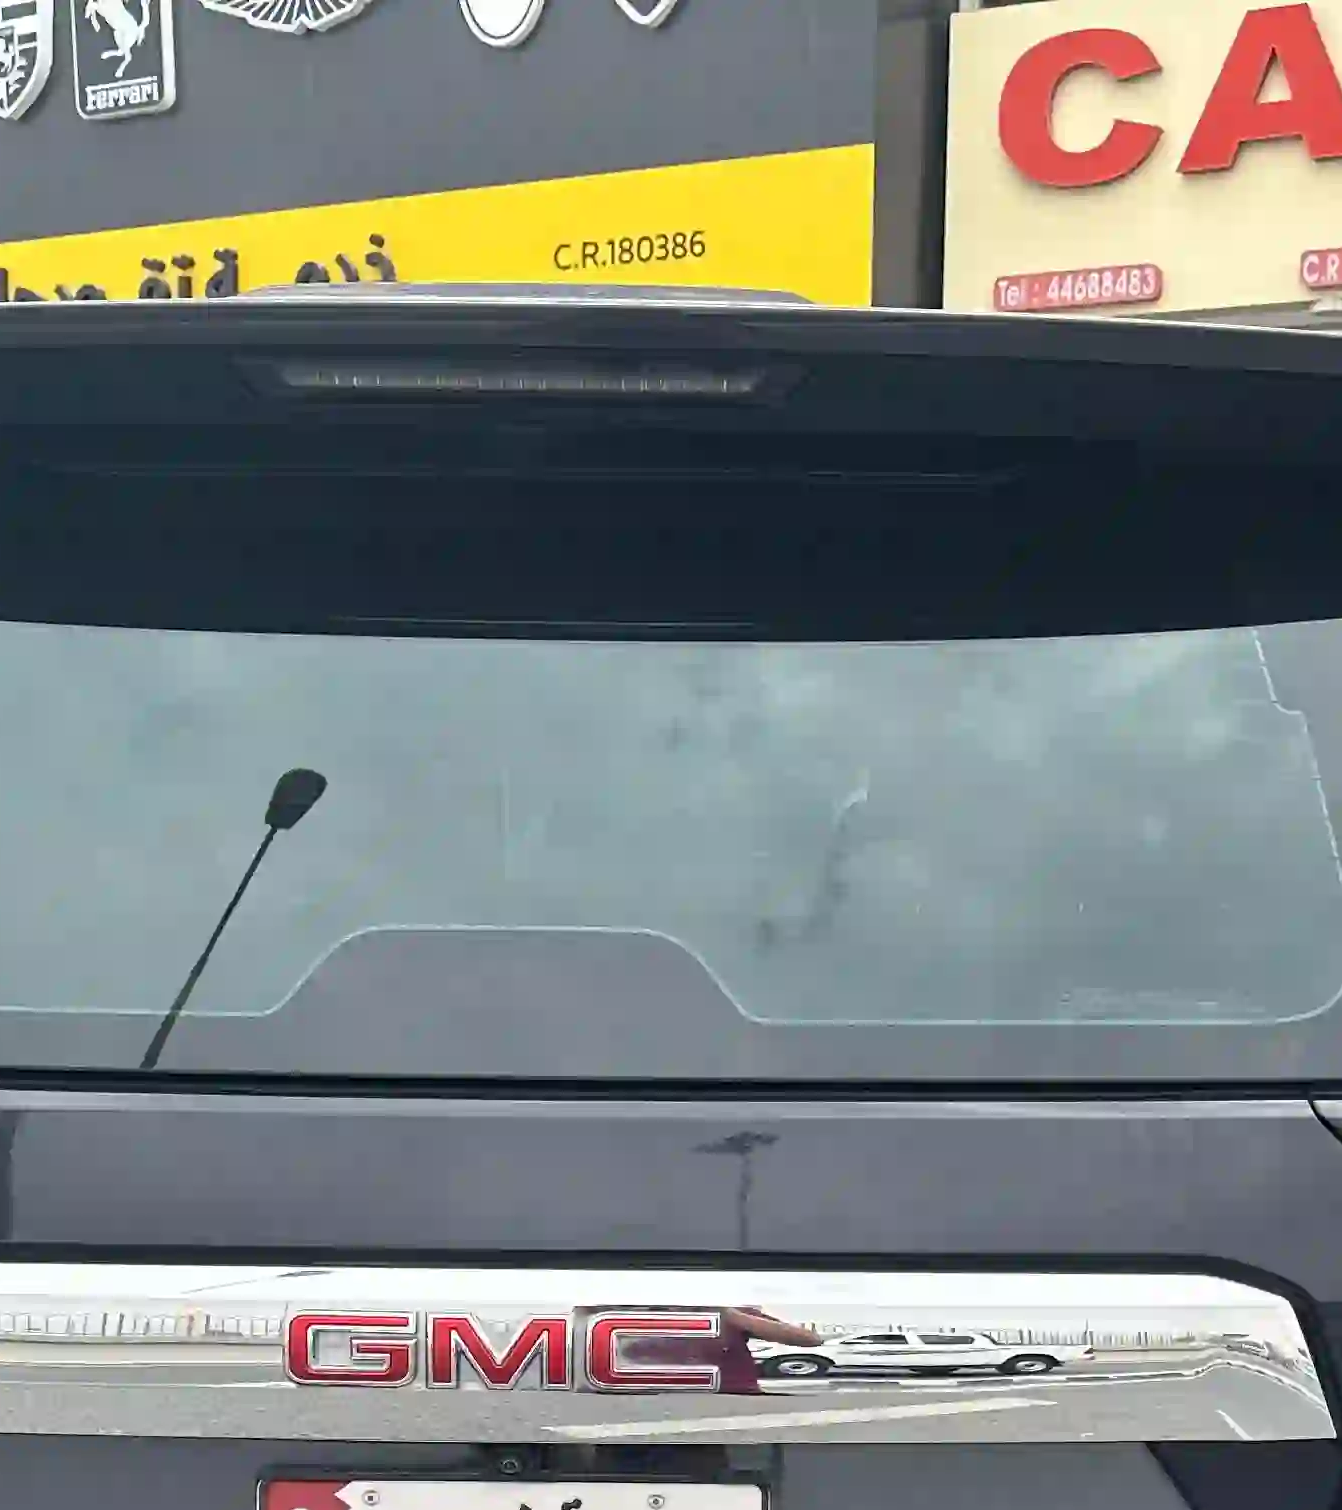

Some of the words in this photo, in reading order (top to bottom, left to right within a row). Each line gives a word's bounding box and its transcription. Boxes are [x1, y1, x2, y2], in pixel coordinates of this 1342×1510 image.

[553, 230, 706, 271] C.R.180386
[998, 278, 1027, 307] Tel
[283, 1309, 723, 1393] GMC
